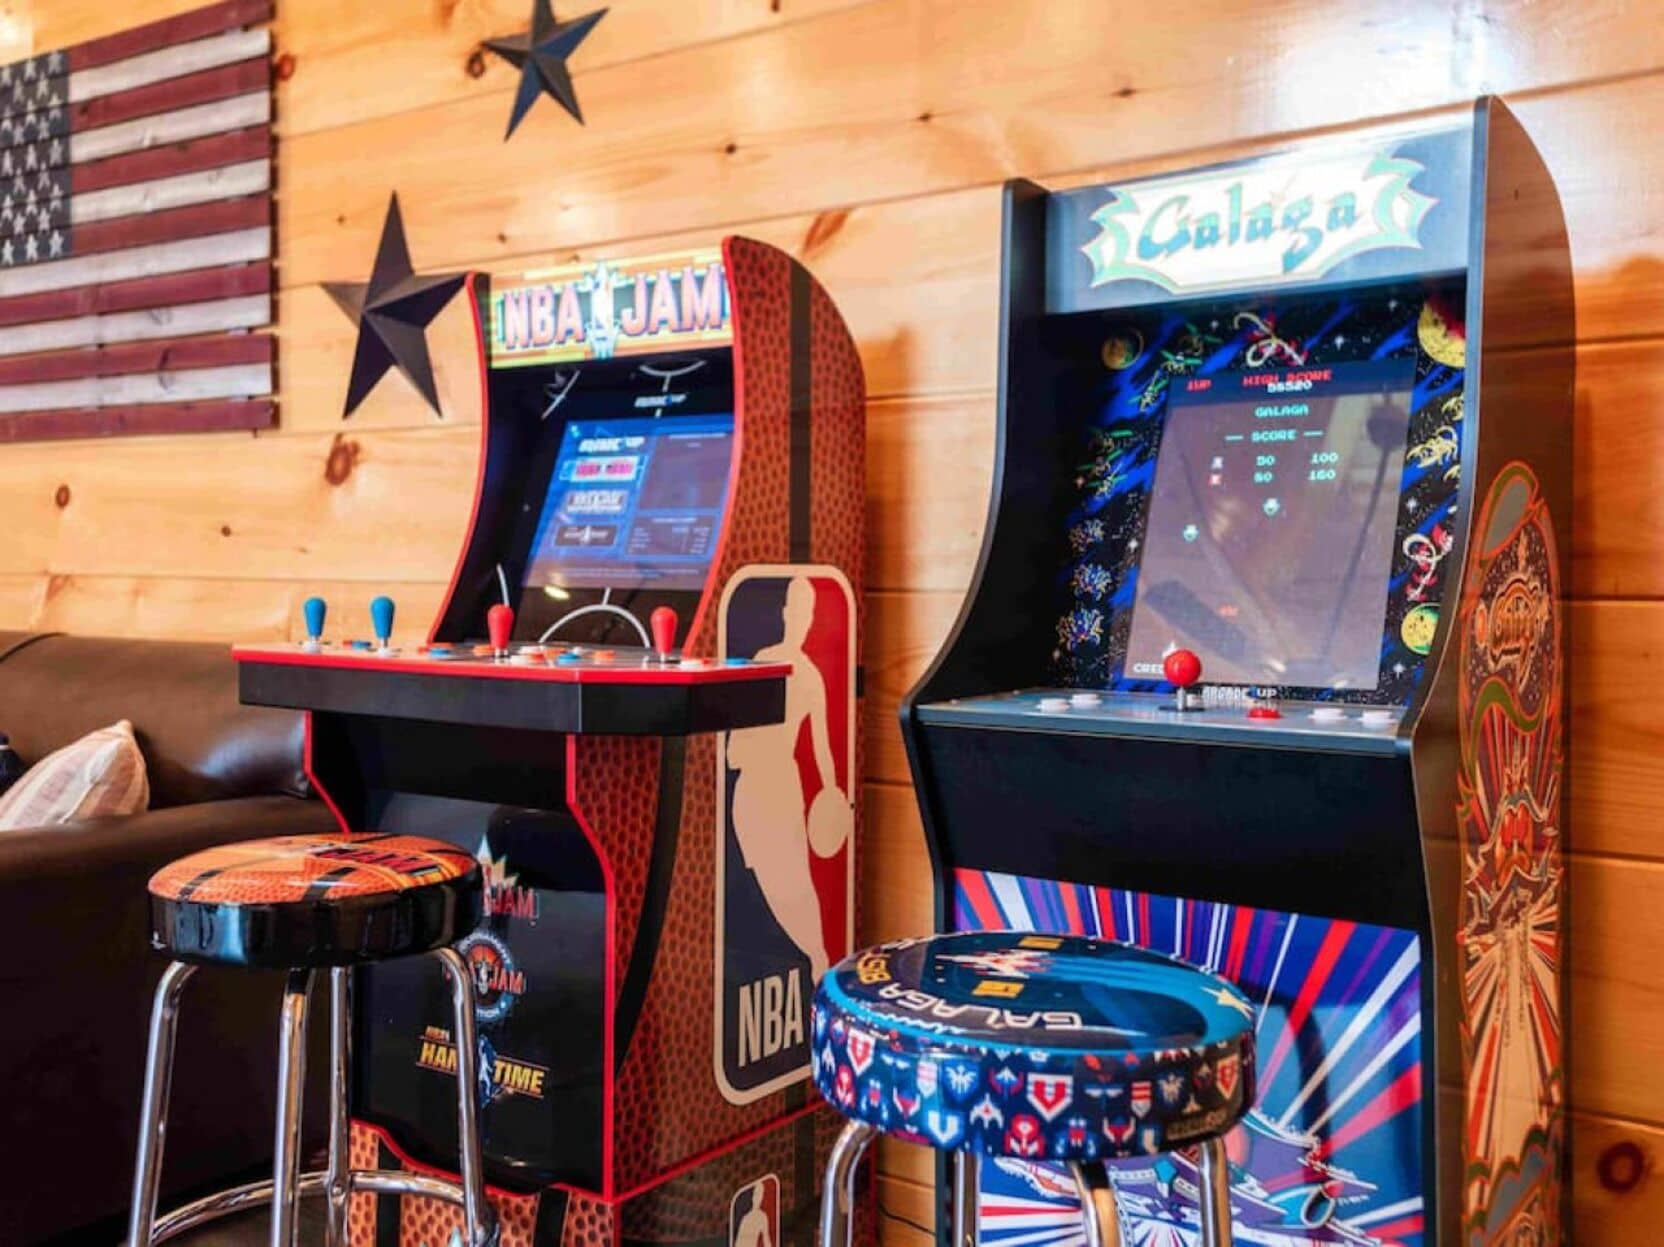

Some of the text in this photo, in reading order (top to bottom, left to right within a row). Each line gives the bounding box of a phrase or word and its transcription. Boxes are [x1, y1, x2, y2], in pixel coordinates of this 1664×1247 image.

[1138, 182, 1360, 273] Galaga
[503, 264, 723, 350] NBA JAM
[1243, 374, 1279, 387] HIGH
[1254, 403, 1310, 418] GALAGA
[1251, 428, 1297, 443] SCORE
[1255, 451, 1339, 467] 50 100
[738, 967, 804, 1068] NBA
[878, 984, 1083, 1031] GALAGA
[421, 1042, 545, 1096] HAN TIME
